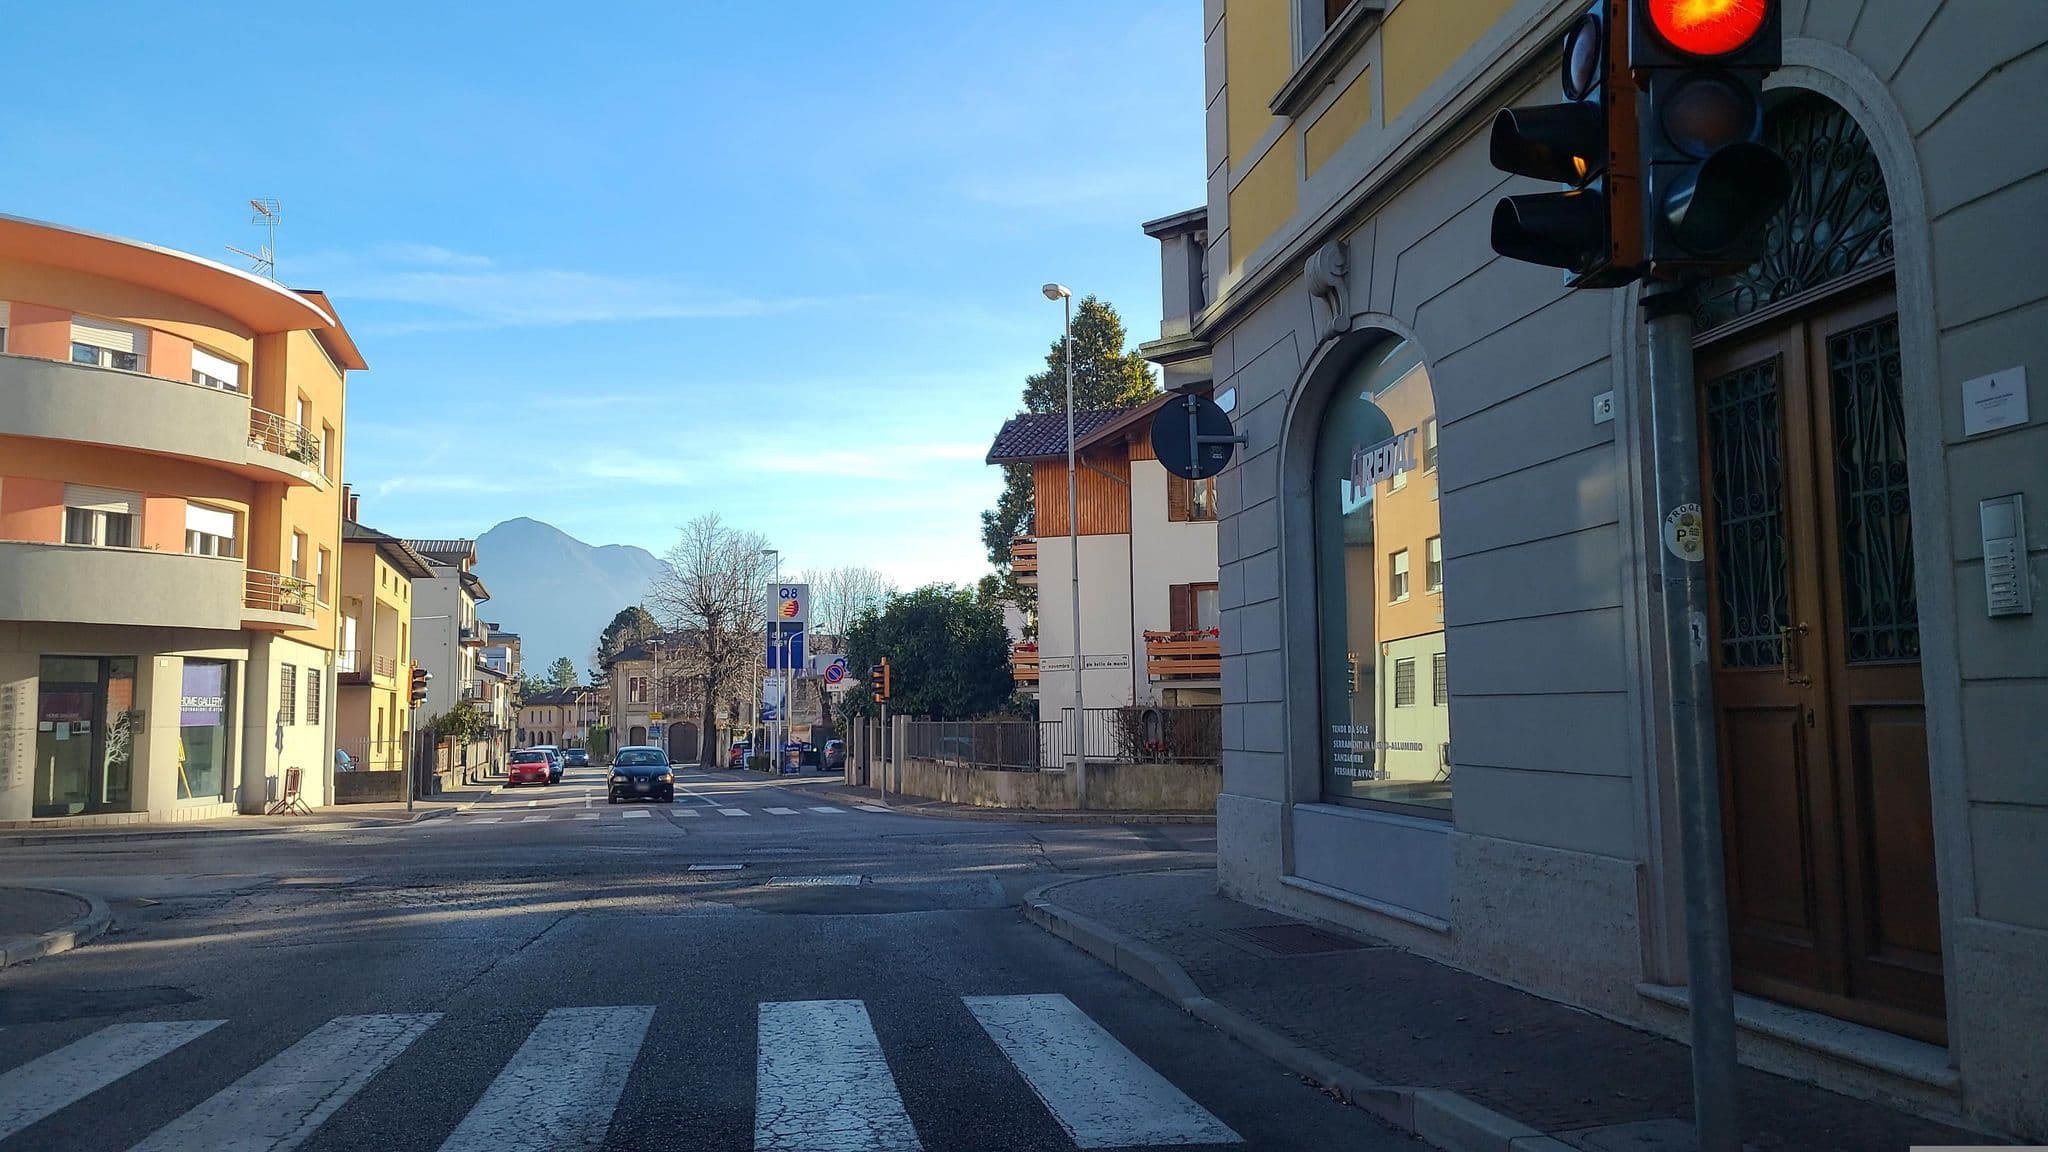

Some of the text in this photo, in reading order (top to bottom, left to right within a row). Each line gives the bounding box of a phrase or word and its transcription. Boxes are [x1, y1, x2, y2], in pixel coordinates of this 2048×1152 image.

[780, 588, 798, 599] Q8
[180, 696, 224, 706] HOME GALLERY
[1332, 725, 1347, 733] TENDE
[1356, 726, 1369, 734] SOLE
[1334, 767, 1357, 776] PERSIANE
